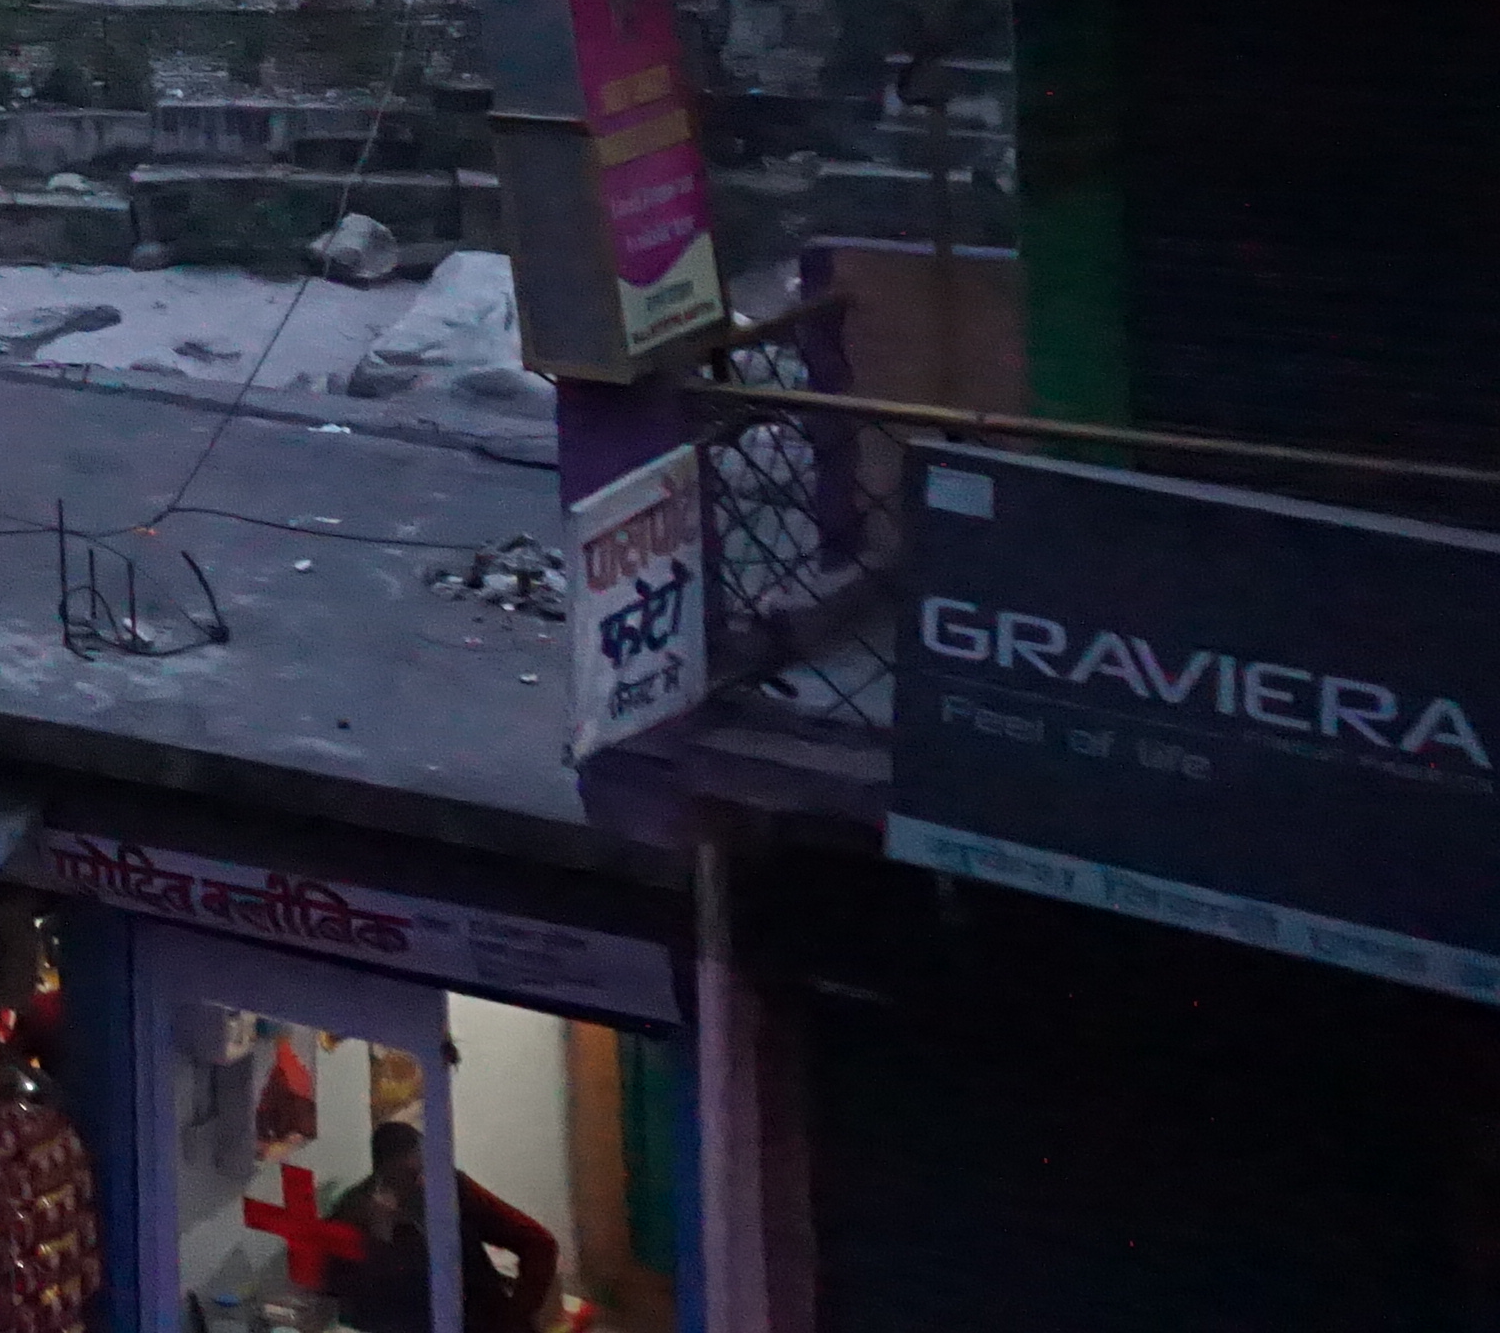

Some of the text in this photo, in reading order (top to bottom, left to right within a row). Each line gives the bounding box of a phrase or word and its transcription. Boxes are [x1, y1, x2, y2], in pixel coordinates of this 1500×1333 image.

[600, 559, 695, 670] फोटो
[920, 596, 1494, 770] GRAVIERA
[941, 695, 1044, 742] Feel
